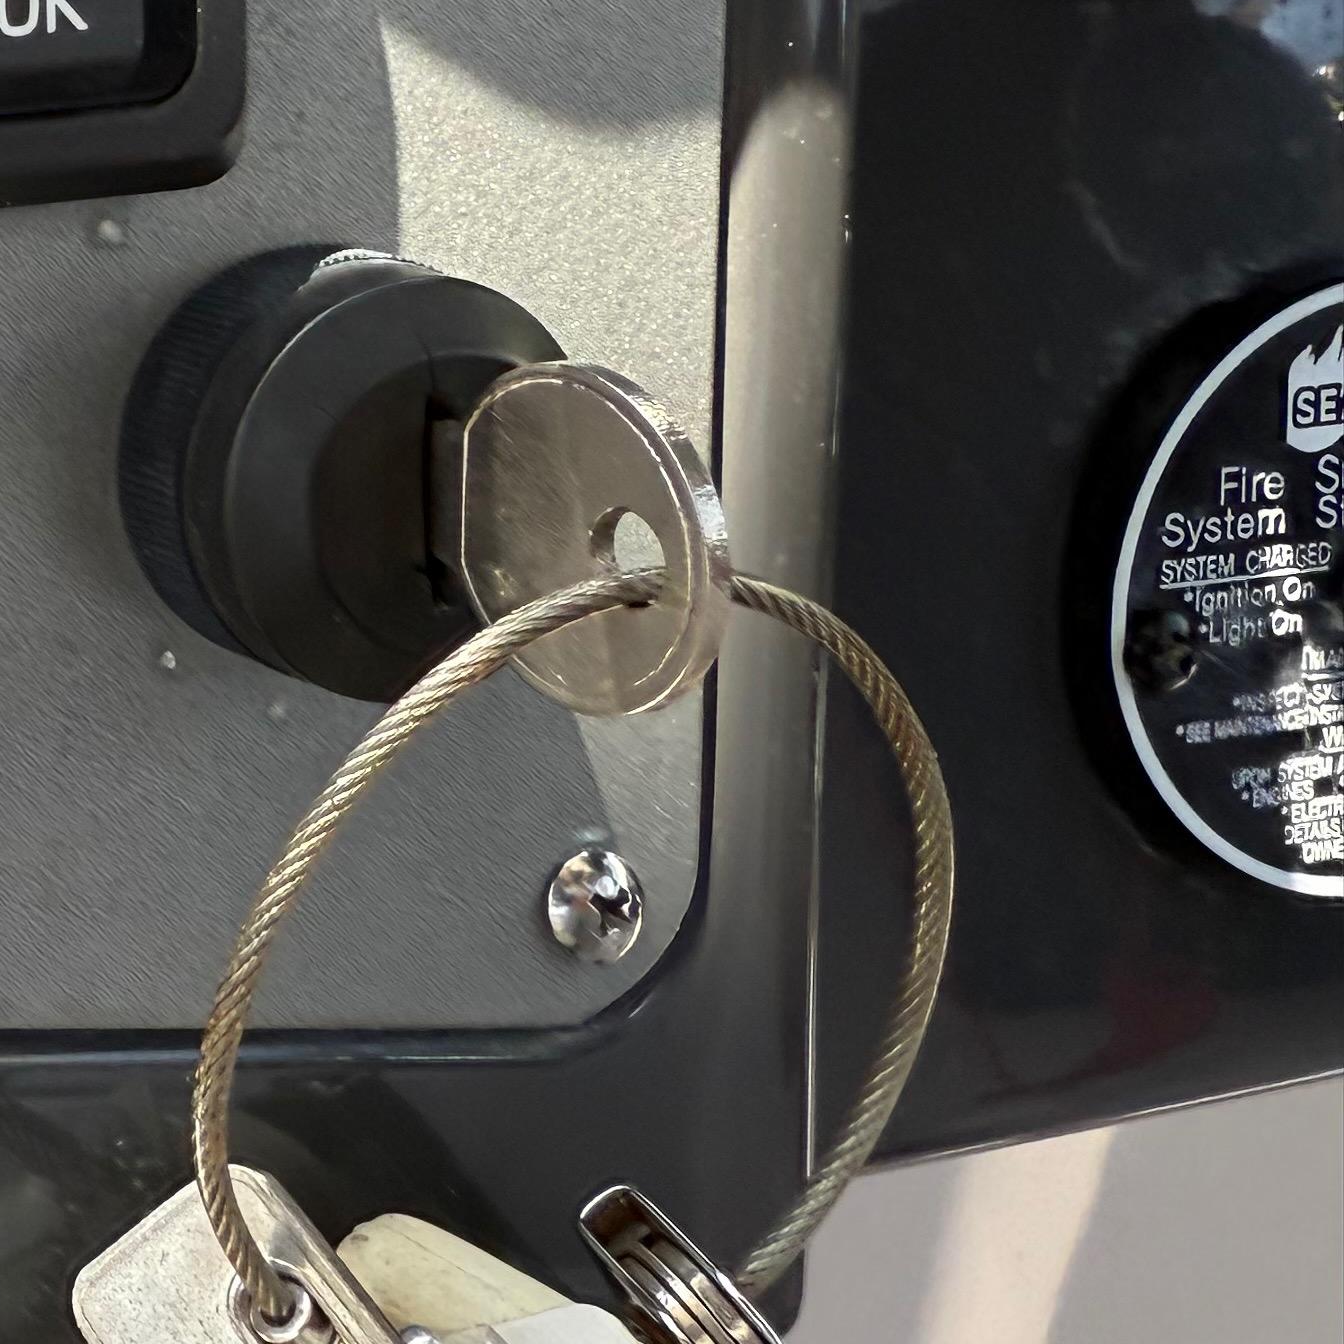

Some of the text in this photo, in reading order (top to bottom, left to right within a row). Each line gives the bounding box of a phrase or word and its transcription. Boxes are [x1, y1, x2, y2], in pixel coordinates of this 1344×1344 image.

[1296, 388, 1344, 425] SE
[1220, 466, 1285, 506] Fire
[1162, 507, 1286, 552] System
[1161, 553, 1235, 584] SYSTEM
[1283, 576, 1316, 601] On
[1271, 609, 1303, 636] On
